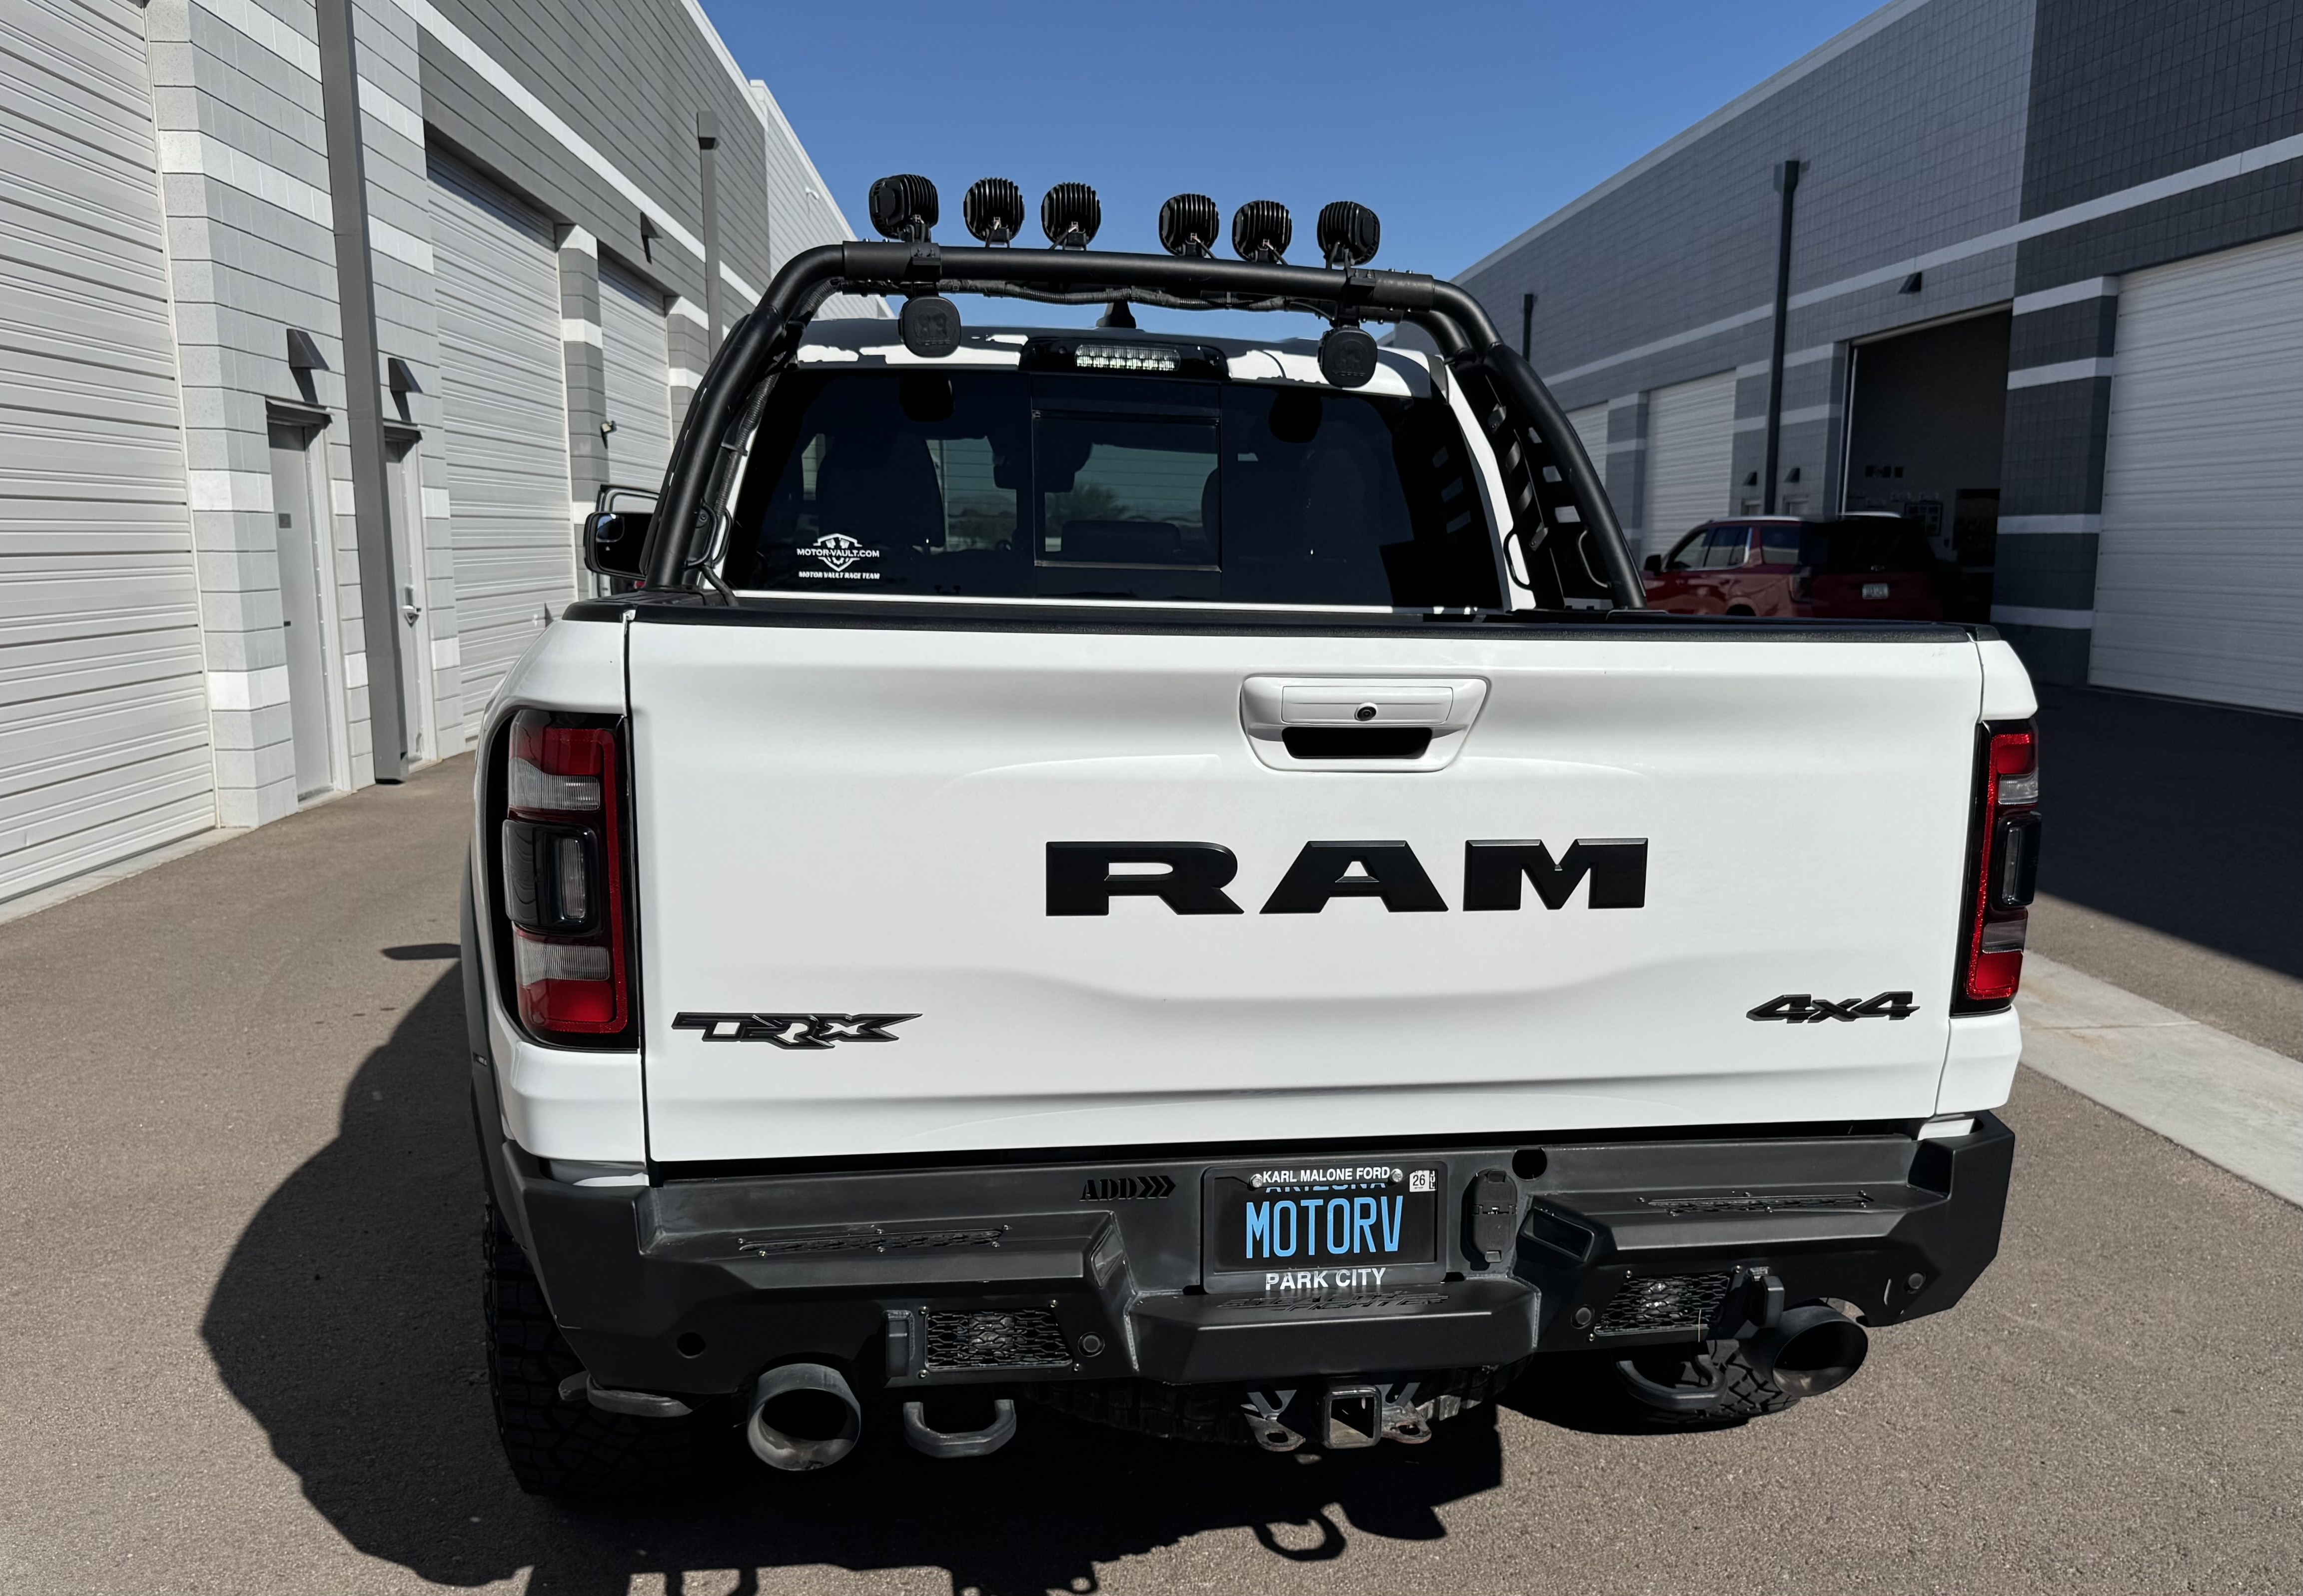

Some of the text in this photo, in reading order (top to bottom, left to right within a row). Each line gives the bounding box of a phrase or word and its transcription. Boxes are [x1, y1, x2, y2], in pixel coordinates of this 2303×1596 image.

[1046, 838, 1648, 916] RAM
[671, 1012, 923, 1049] TRX
[1263, 1166, 1390, 1183] KARL MALONE FORD
[1413, 1174, 1426, 1186] 26
[1079, 1177, 1137, 1201] ADD
[1246, 1196, 1403, 1259] MOTORV
[1265, 1267, 1386, 1290] PARK CITY
